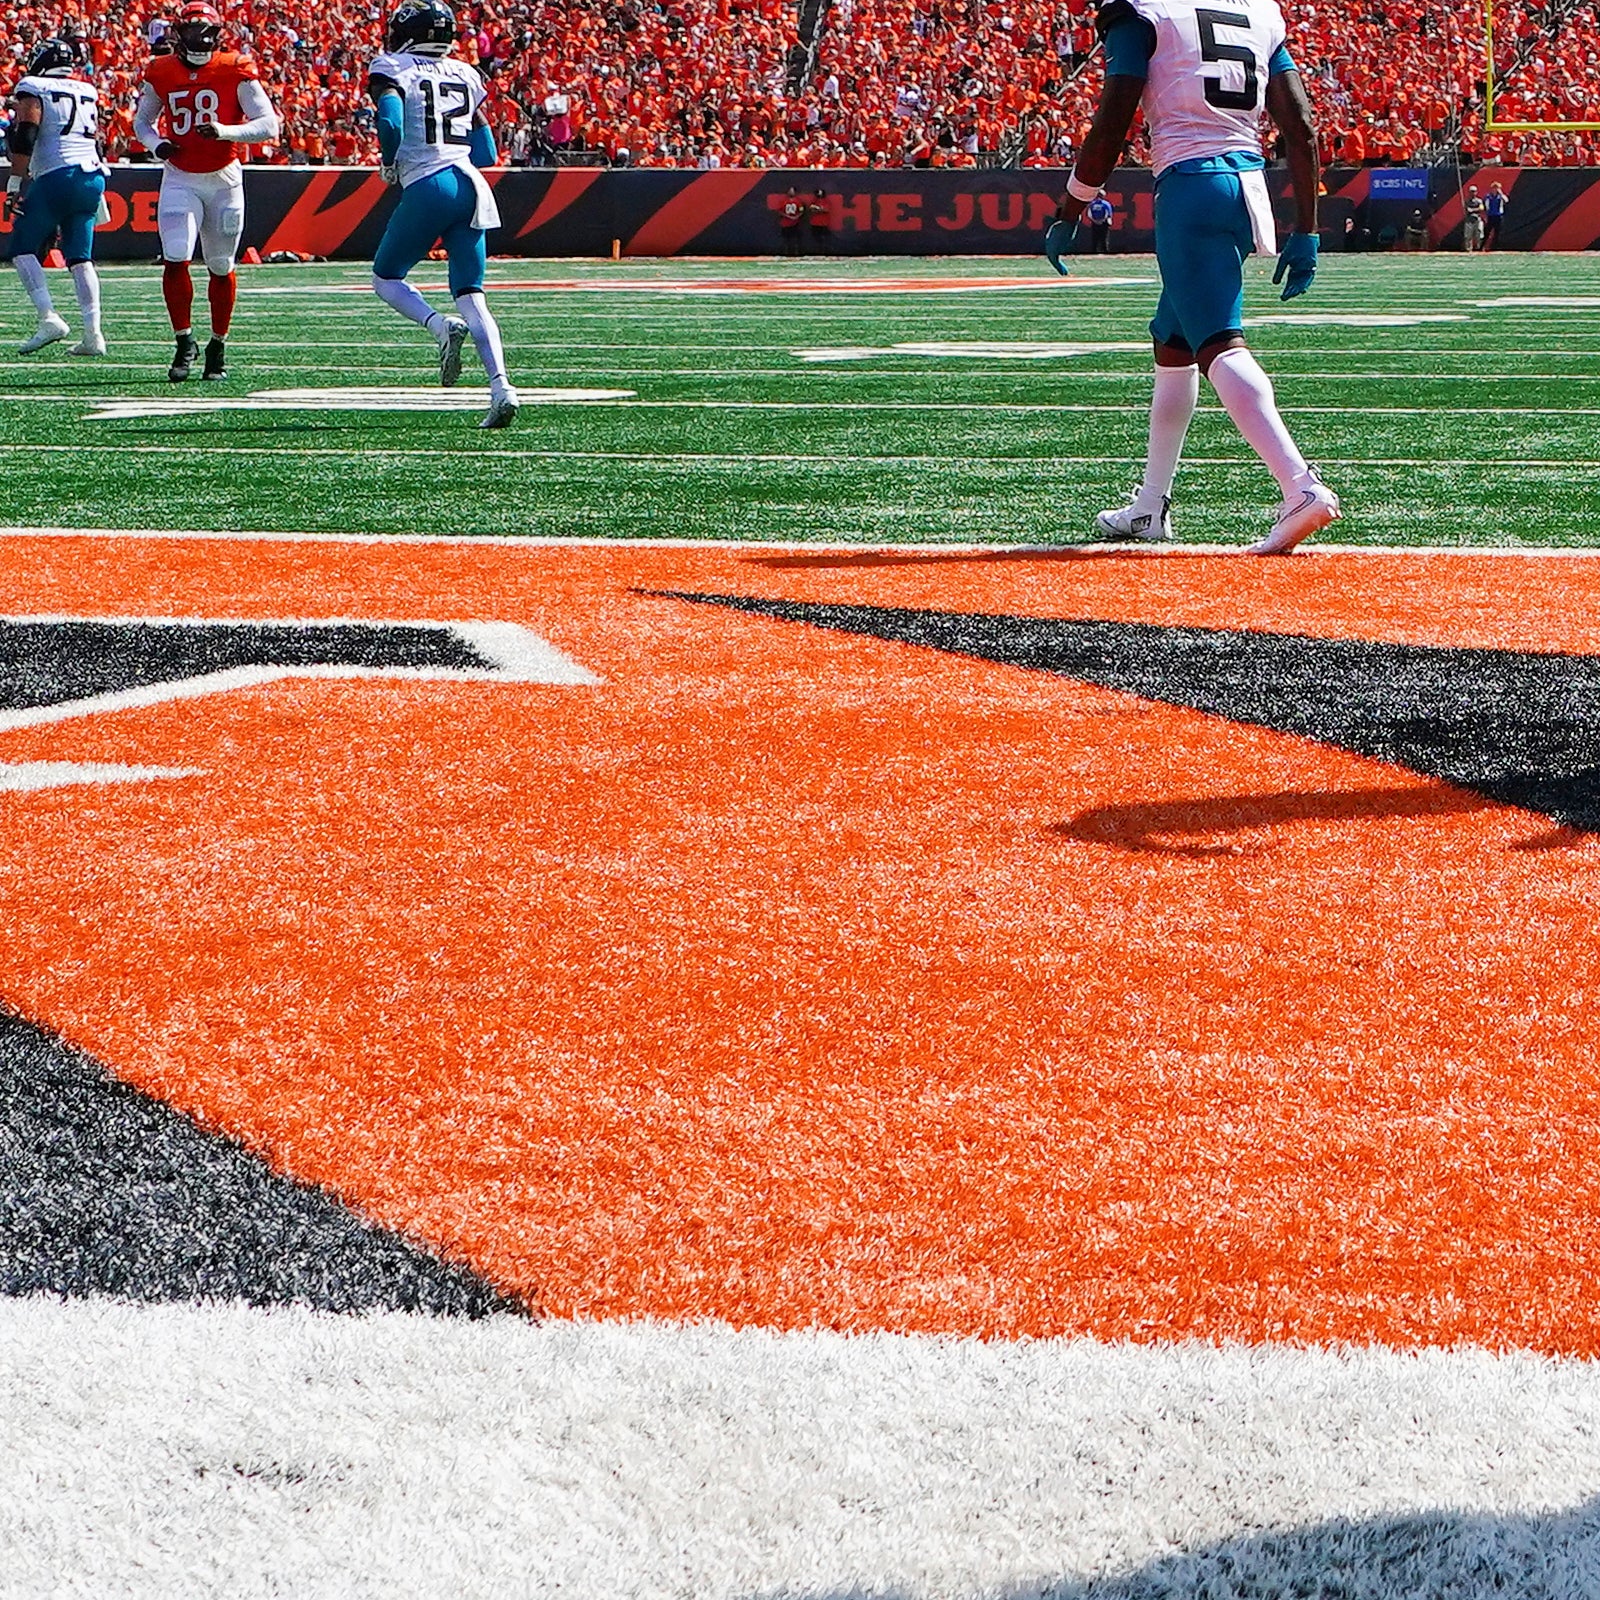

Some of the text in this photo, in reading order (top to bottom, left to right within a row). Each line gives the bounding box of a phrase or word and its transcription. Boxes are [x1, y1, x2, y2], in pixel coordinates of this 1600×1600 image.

[1194, 7, 1259, 111] 5
[168, 89, 220, 136] 58
[419, 79, 473, 146] 12
